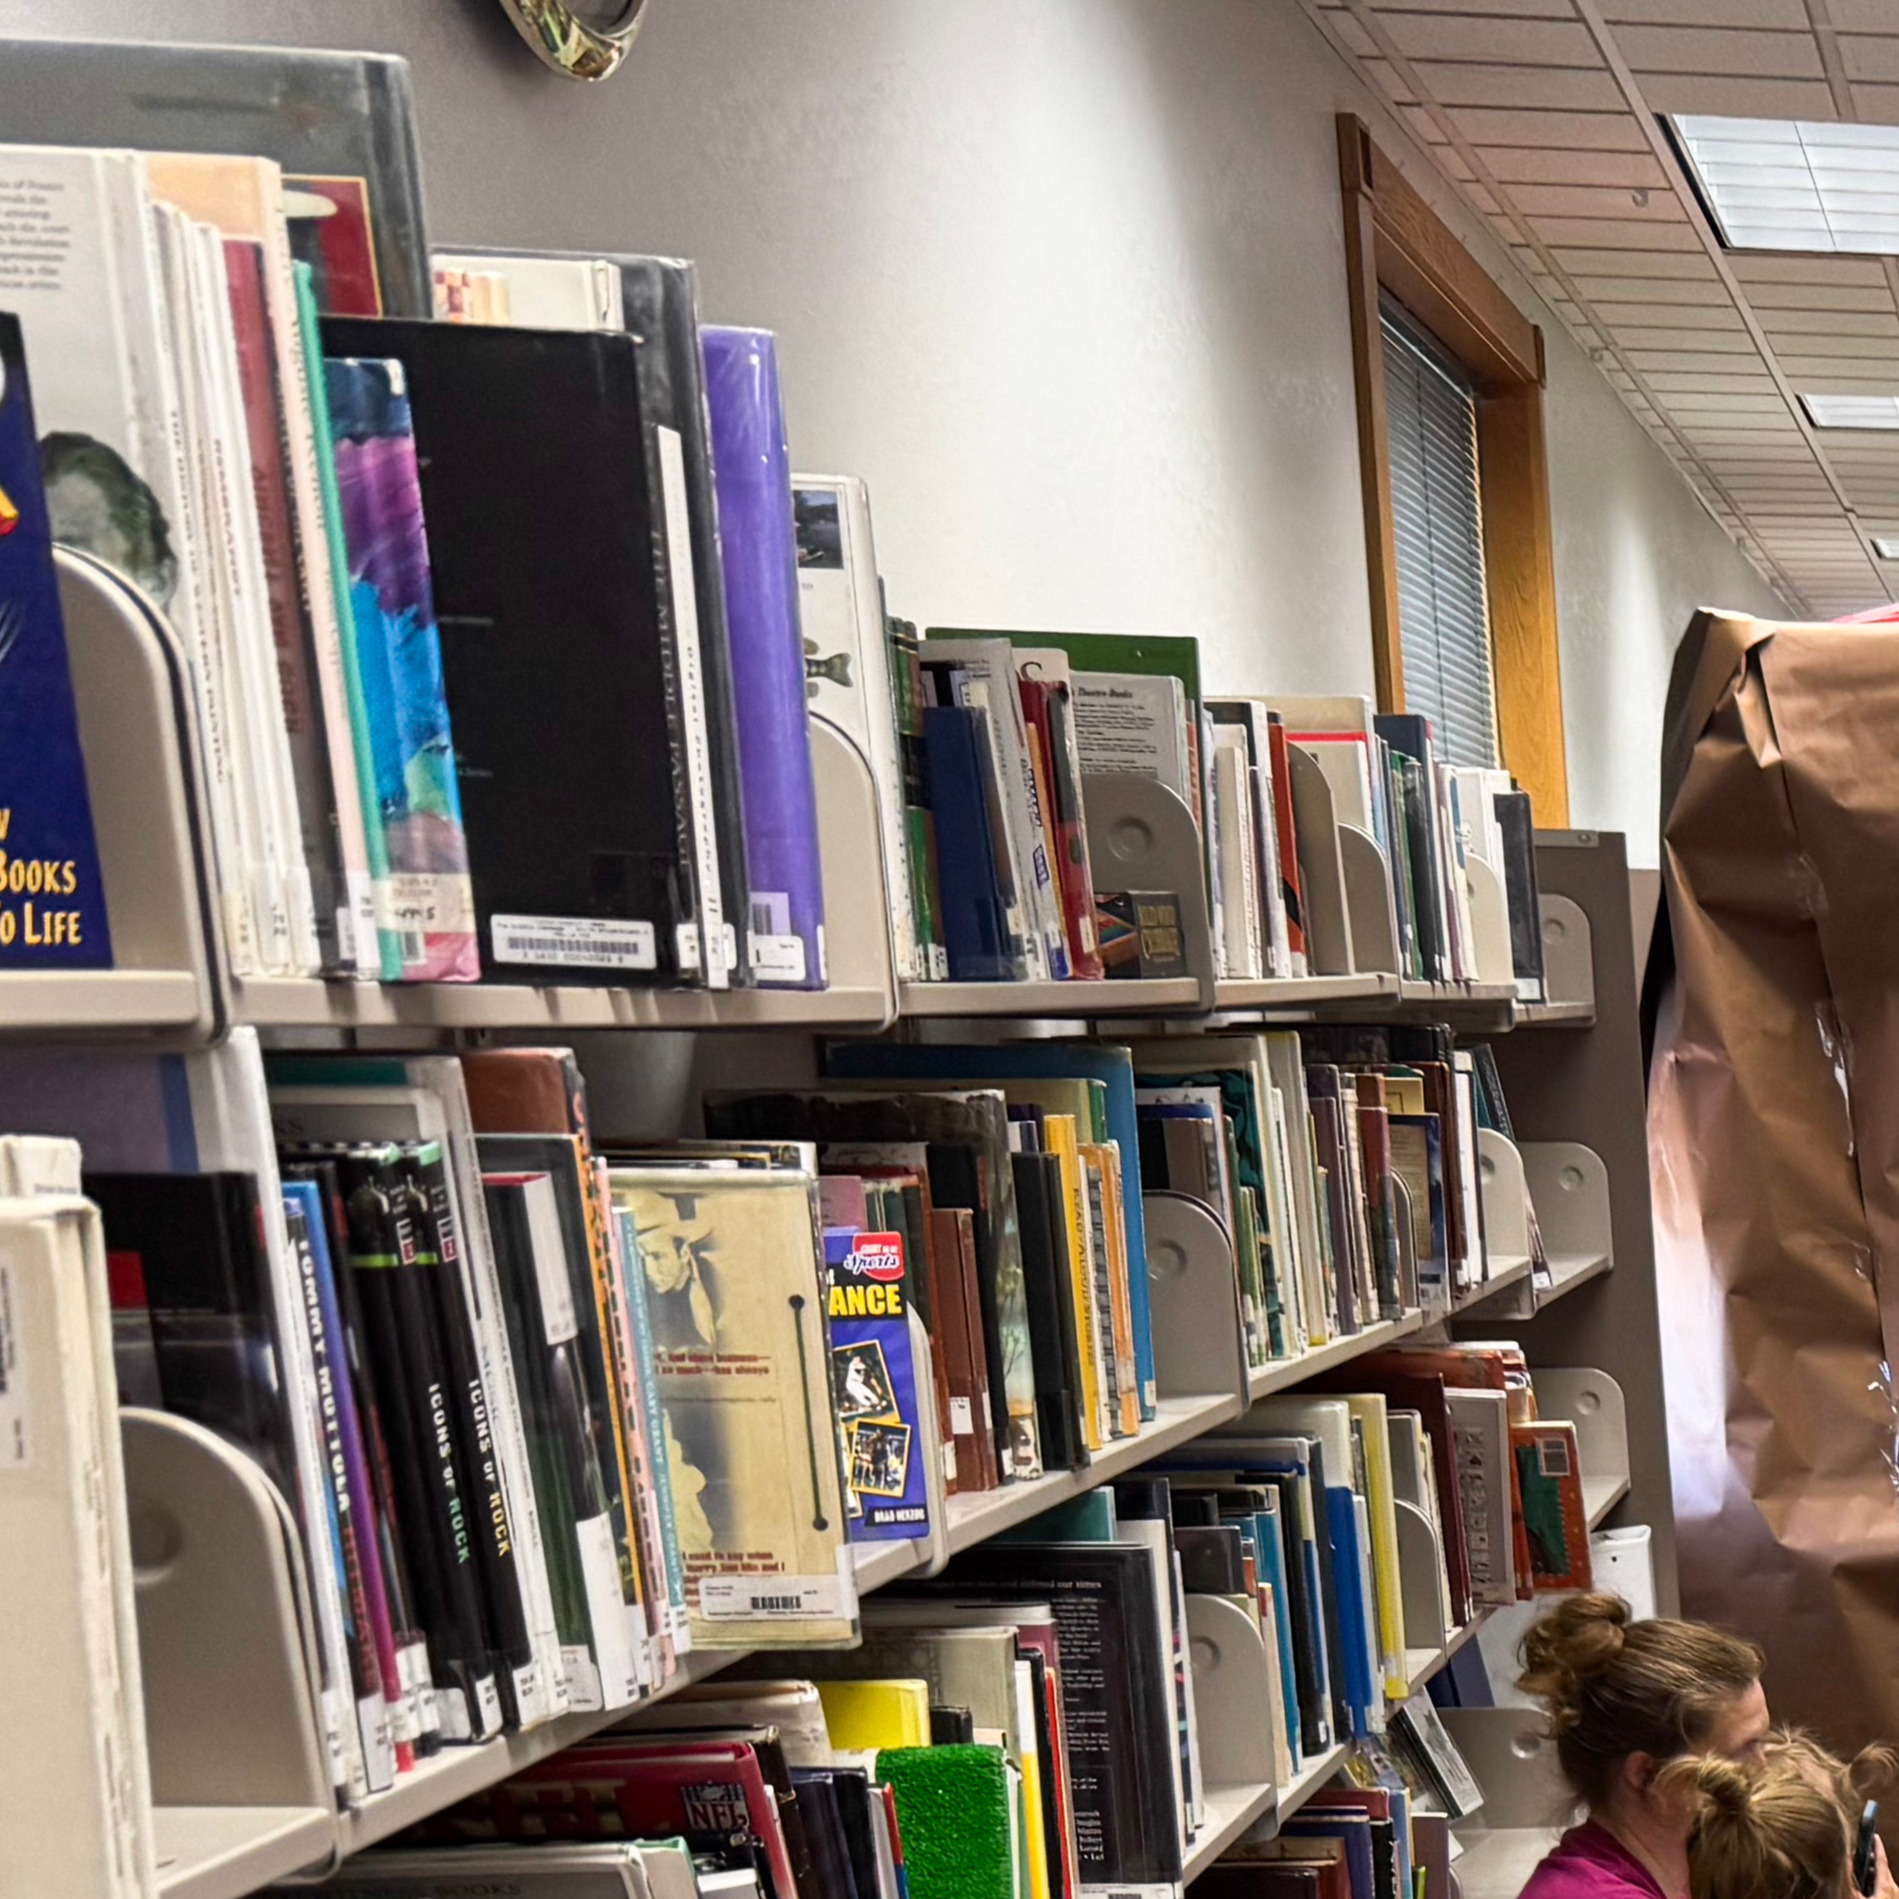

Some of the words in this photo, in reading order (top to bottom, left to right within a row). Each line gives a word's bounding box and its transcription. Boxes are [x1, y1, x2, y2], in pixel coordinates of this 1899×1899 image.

[24, 902, 81, 946] LIFE
[844, 1252, 900, 1275] Sports
[829, 1286, 901, 1316] ANCE
[299, 1239, 326, 1354] TOMMY
[319, 1366, 349, 1512] MOTTOLA
[428, 1383, 452, 1459] ICONS
[449, 1497, 471, 1563] ROCK
[468, 1379, 493, 1453] ICONS
[489, 1492, 511, 1557] ROCK
[692, 1802, 743, 1830] NFL
